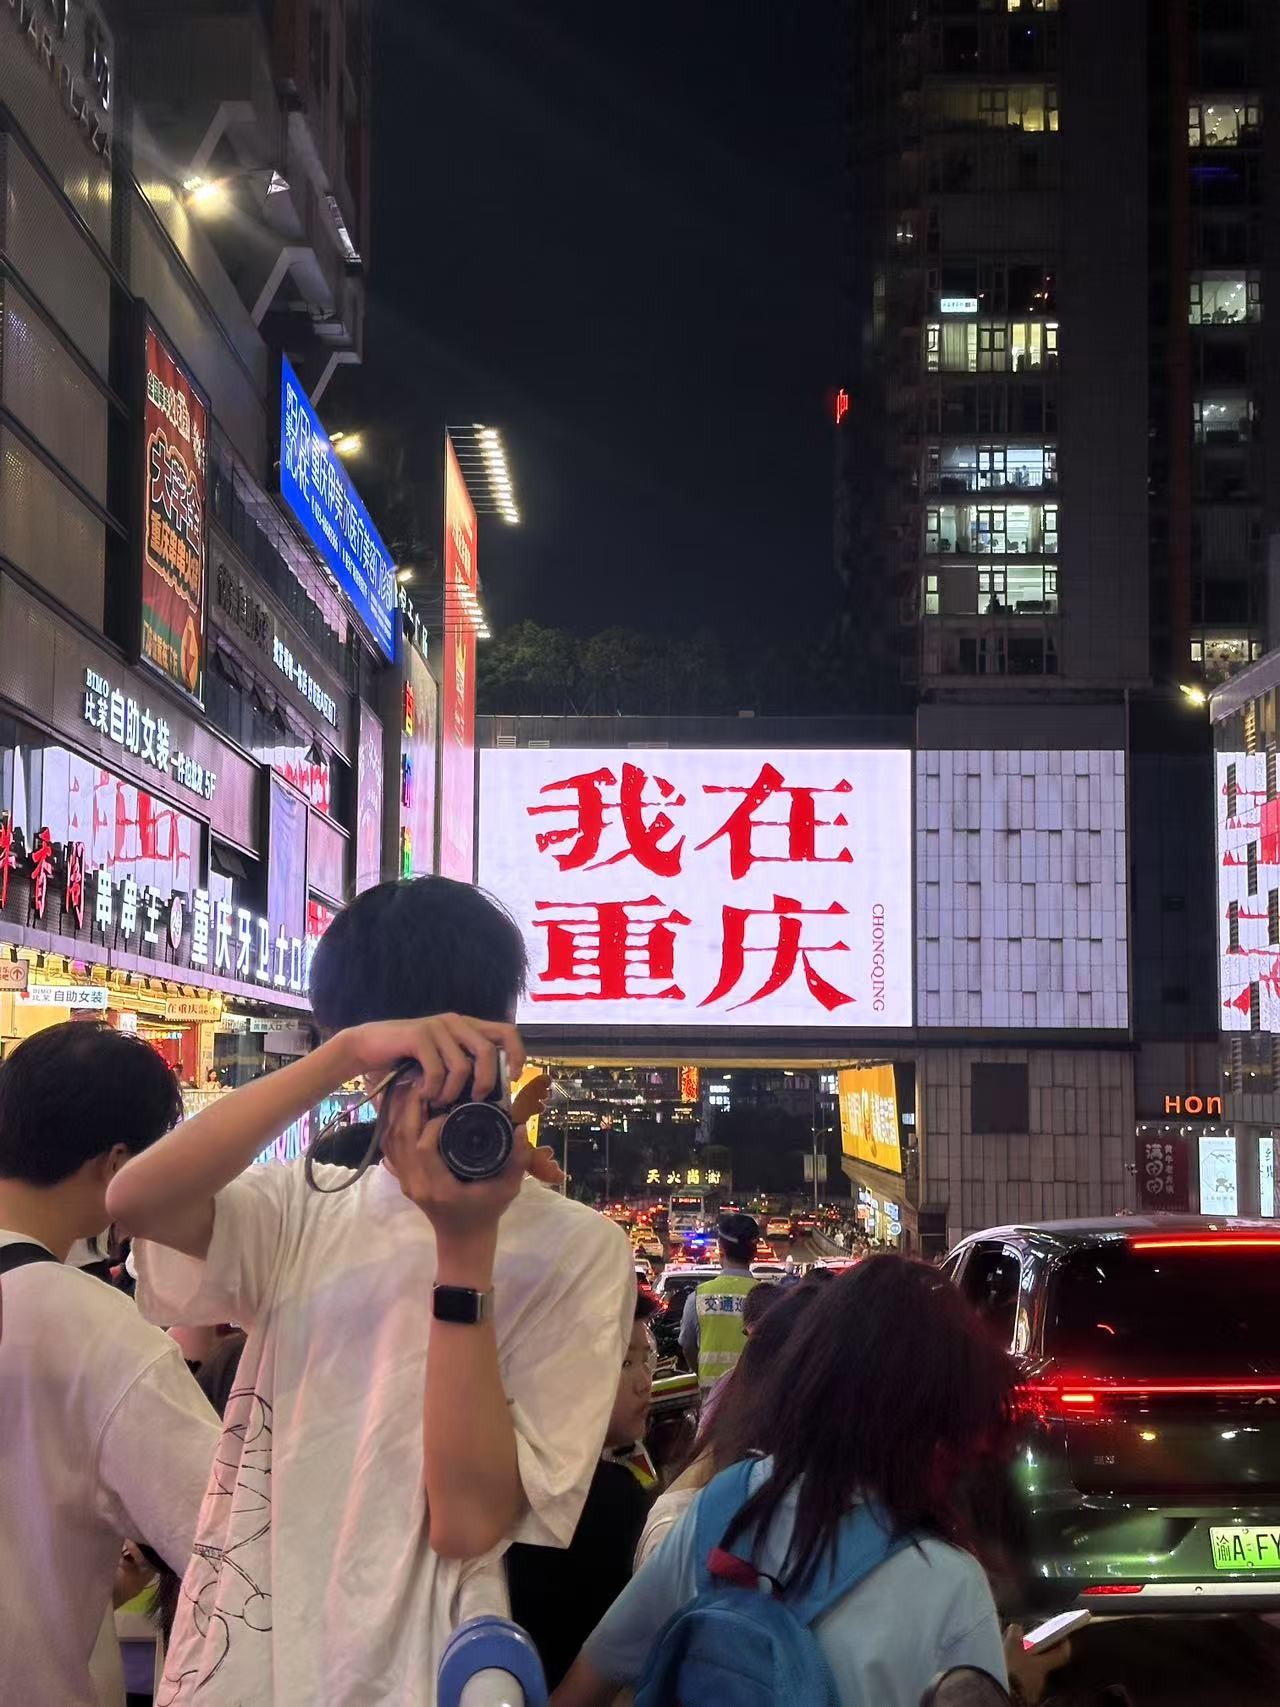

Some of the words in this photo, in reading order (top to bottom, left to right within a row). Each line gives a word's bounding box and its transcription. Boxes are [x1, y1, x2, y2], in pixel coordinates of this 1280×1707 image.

[86, 668, 109, 698] BIMO
[110, 688, 170, 773] 自助女装
[204, 771, 217, 800] 5F
[526, 762, 854, 880] 我在
[191, 888, 316, 991] 重庆牙卫士口
[528, 894, 857, 1012] 重庆
[872, 903, 885, 1013] CHONGQING
[54, 990, 102, 1003] 自助女装
